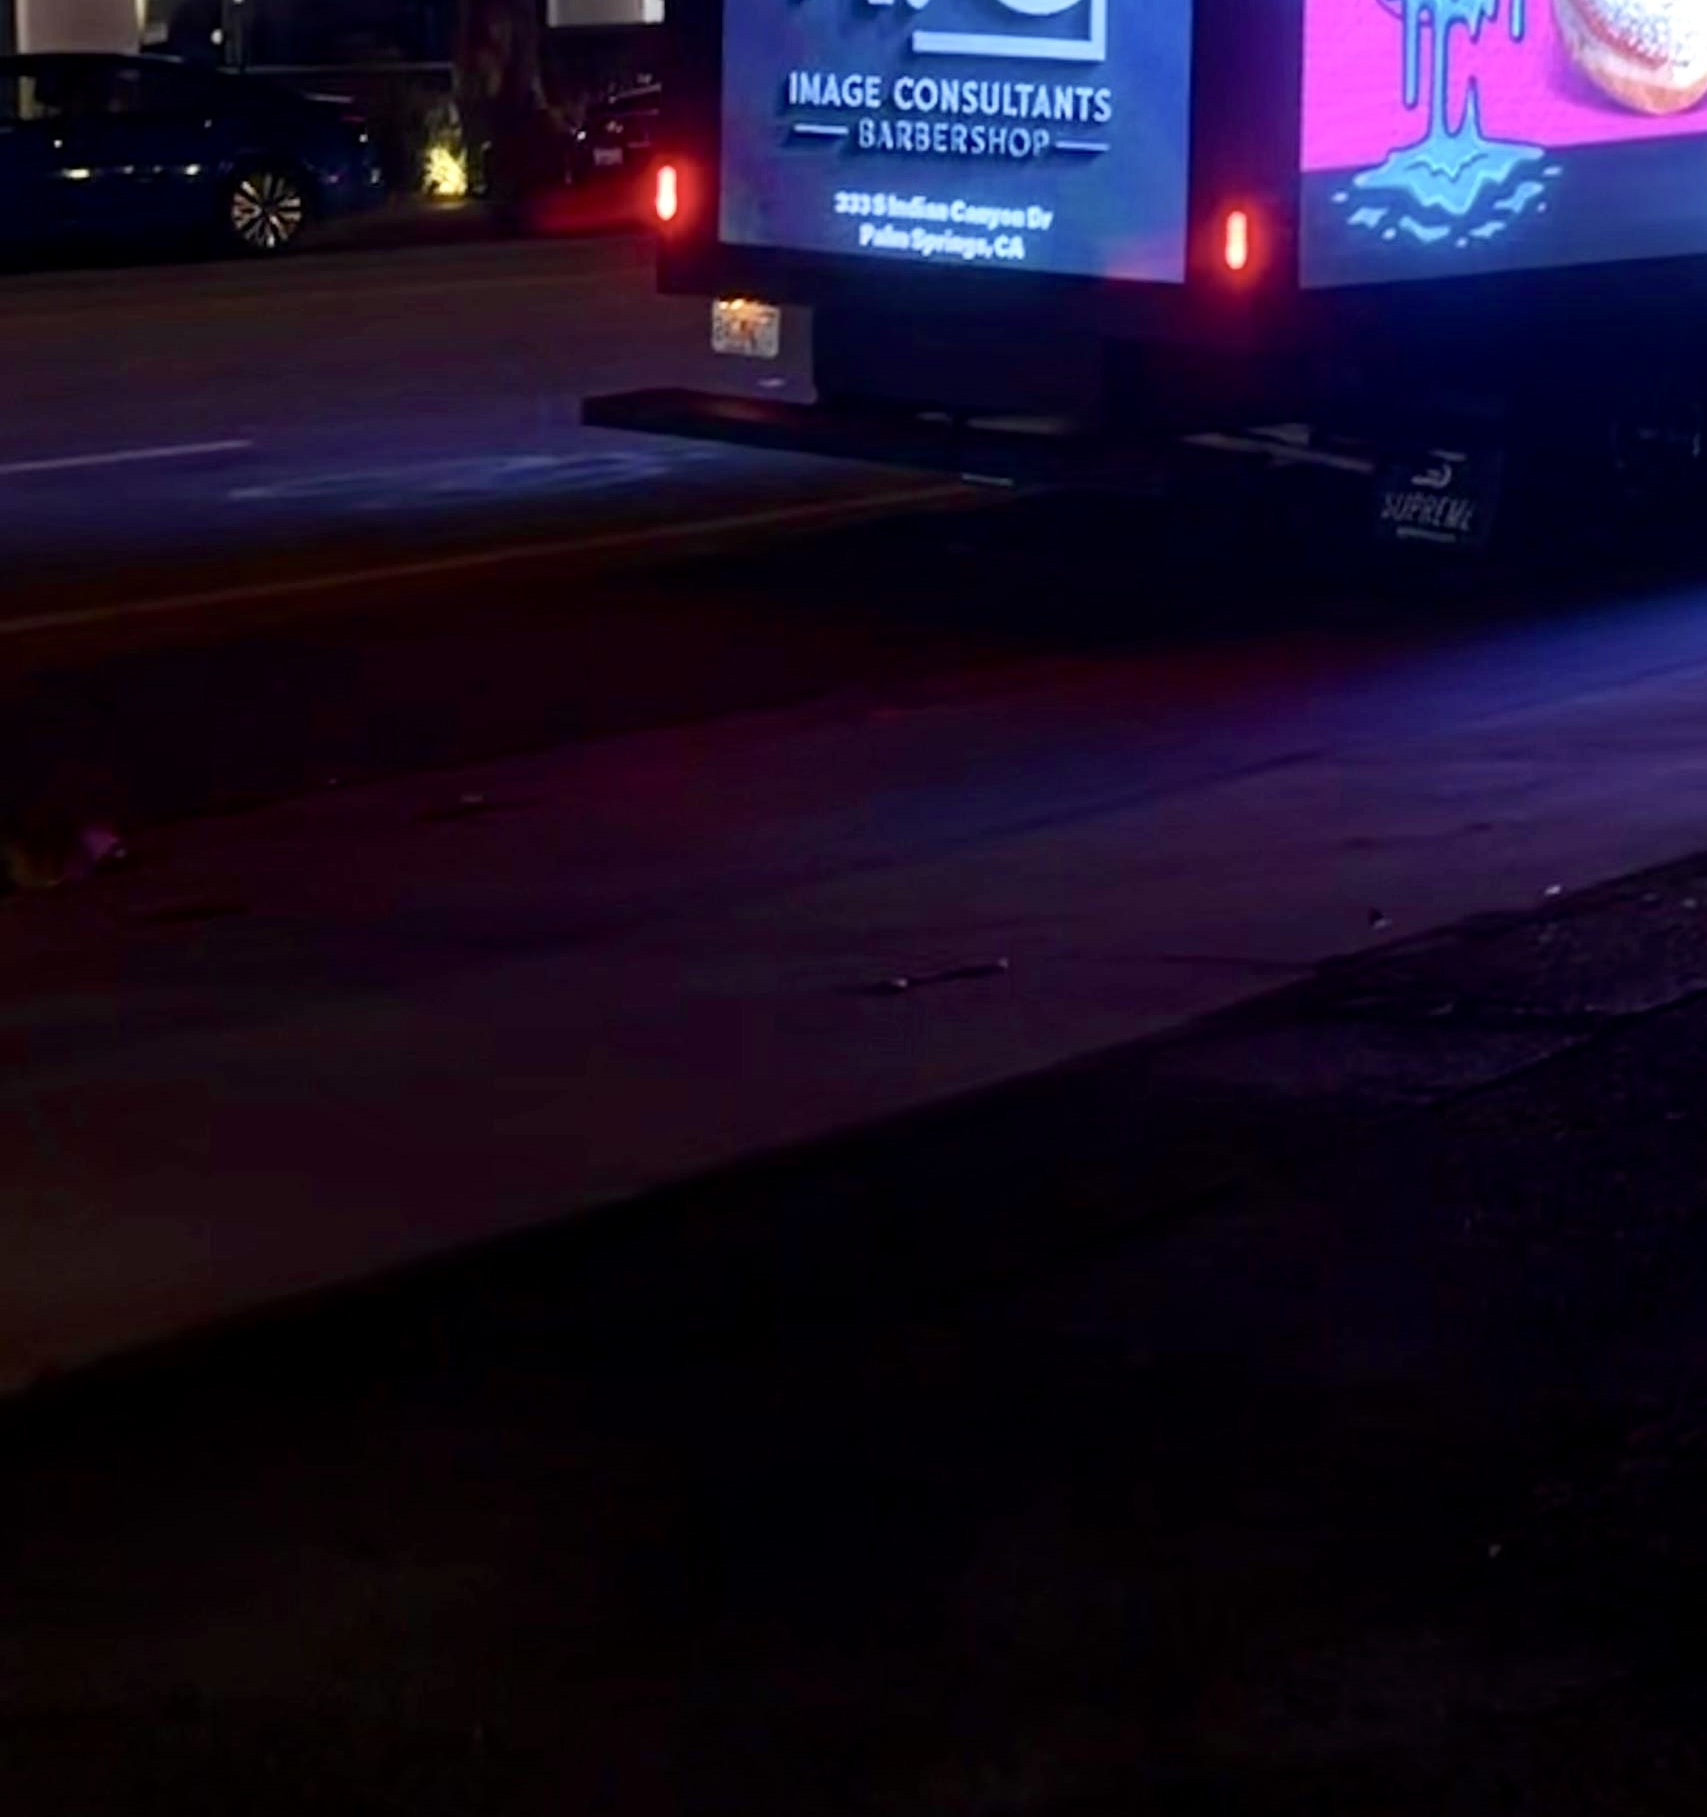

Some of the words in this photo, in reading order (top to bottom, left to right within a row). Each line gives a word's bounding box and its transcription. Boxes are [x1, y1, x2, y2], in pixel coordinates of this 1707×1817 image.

[789, 72, 882, 109] IMAGE
[894, 76, 1112, 122] CONSULTANTS
[858, 117, 1050, 158] BARBERSHOP
[887, 194, 948, 222] Indian
[949, 198, 1025, 230] Canyon
[1026, 205, 1053, 230] Dr
[858, 223, 909, 250] Palm
[993, 235, 1025, 260] CA
